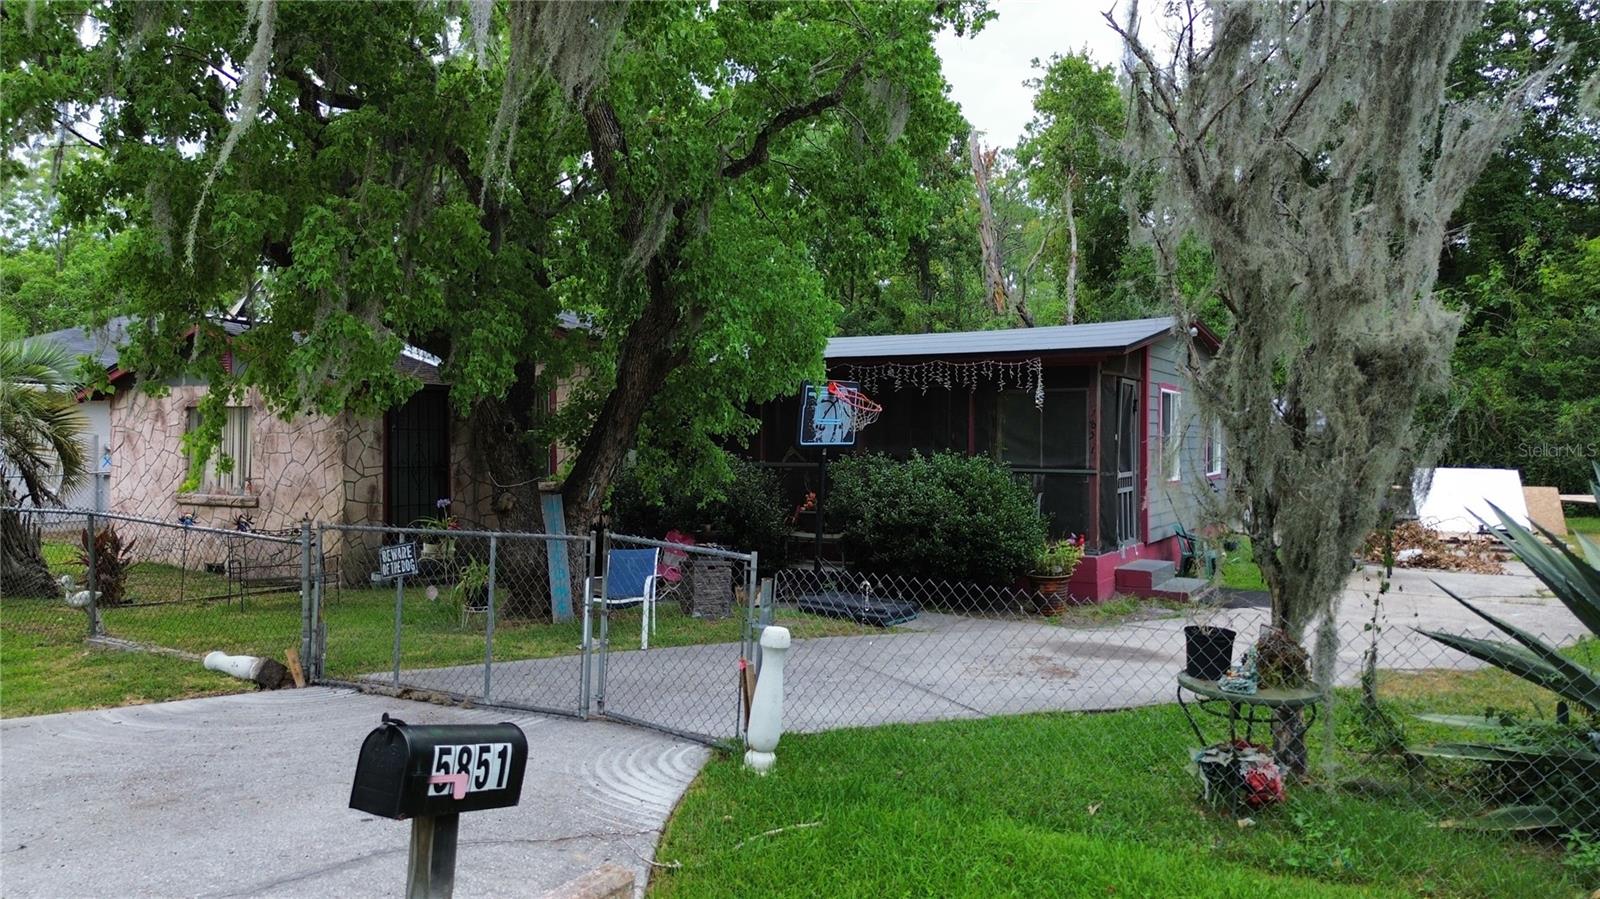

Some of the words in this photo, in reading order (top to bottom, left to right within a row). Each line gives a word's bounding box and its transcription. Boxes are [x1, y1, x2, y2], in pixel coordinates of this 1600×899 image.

[381, 545, 413, 562] BEWARE
[382, 562, 390, 576] OF
[390, 560, 401, 574] THE
[401, 558, 416, 572] DOG
[433, 744, 508, 794] 5851
